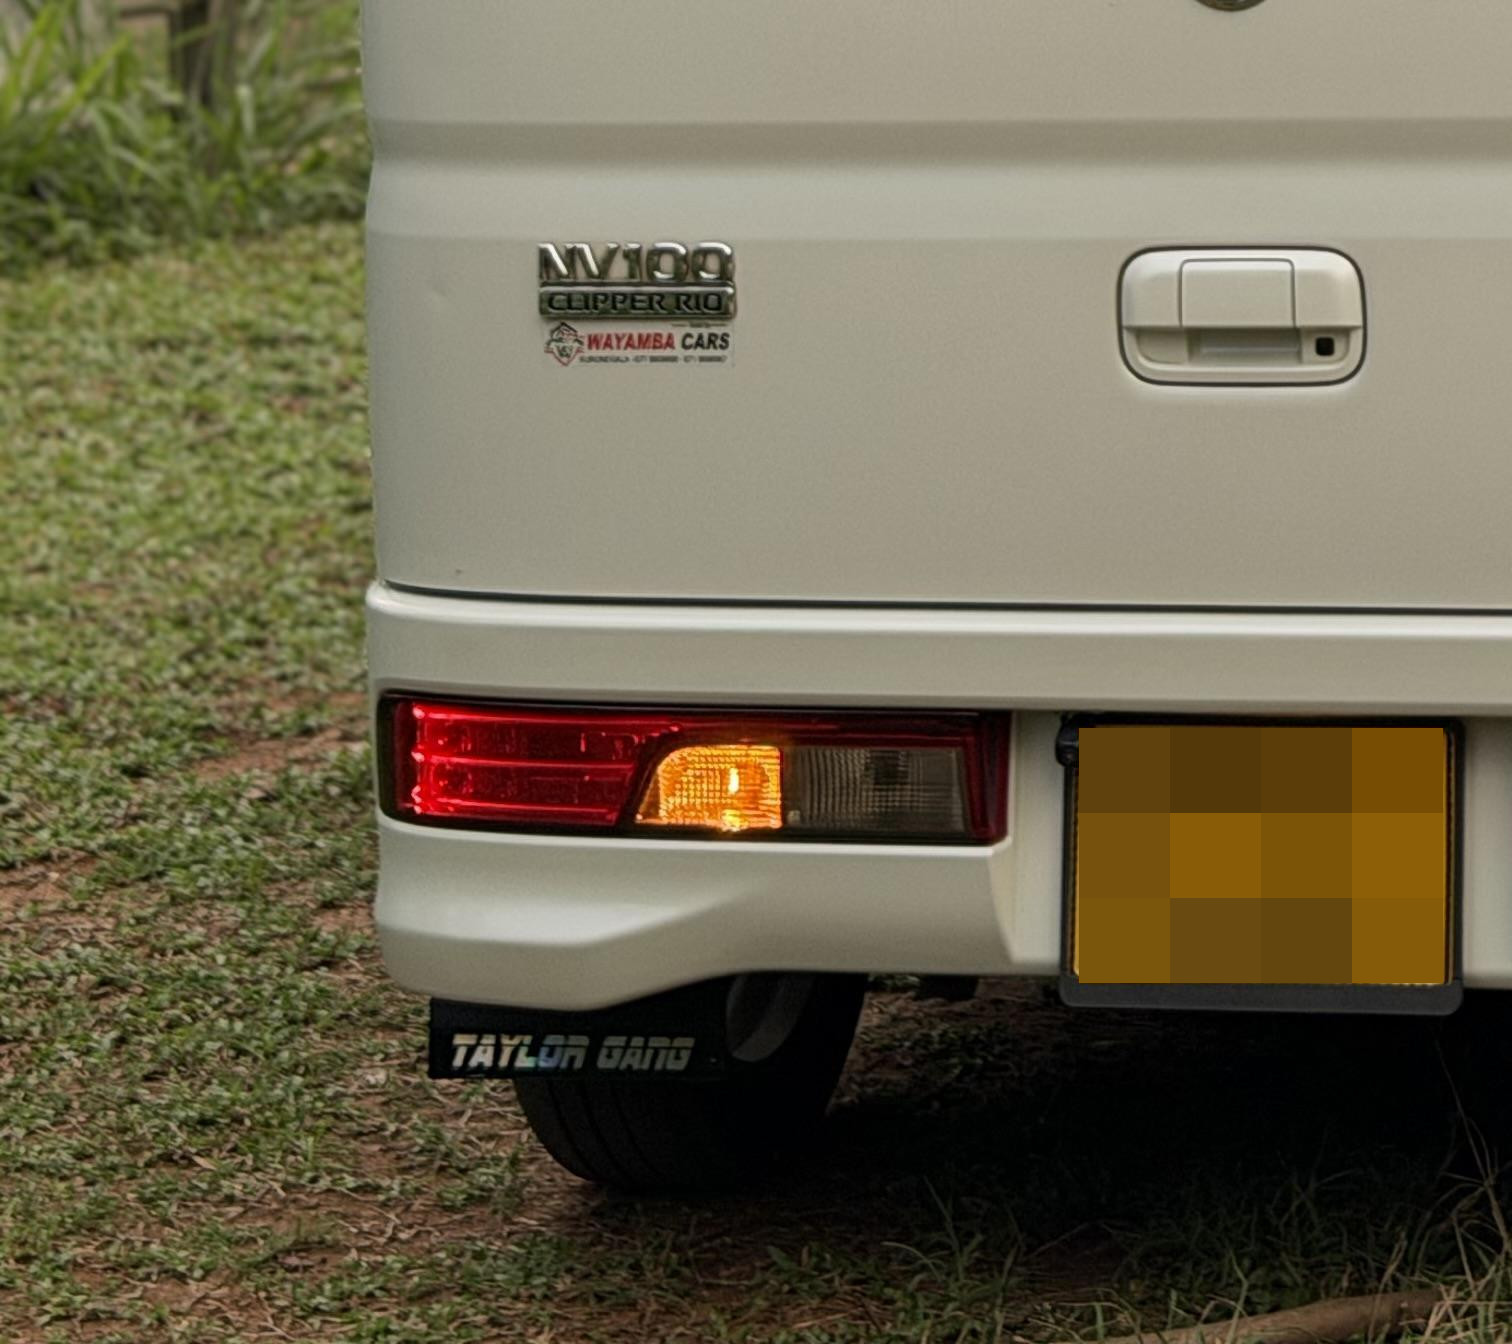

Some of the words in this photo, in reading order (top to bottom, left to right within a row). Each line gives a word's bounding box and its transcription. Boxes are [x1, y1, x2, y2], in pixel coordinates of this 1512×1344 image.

[538, 241, 736, 282] NV100
[548, 292, 664, 311] CLIPPER
[676, 292, 723, 311] RIO
[587, 332, 676, 351] WAYAMBA
[681, 332, 730, 350] CARS
[451, 1033, 590, 1070] TAYLOR
[596, 1035, 695, 1071] GANG
